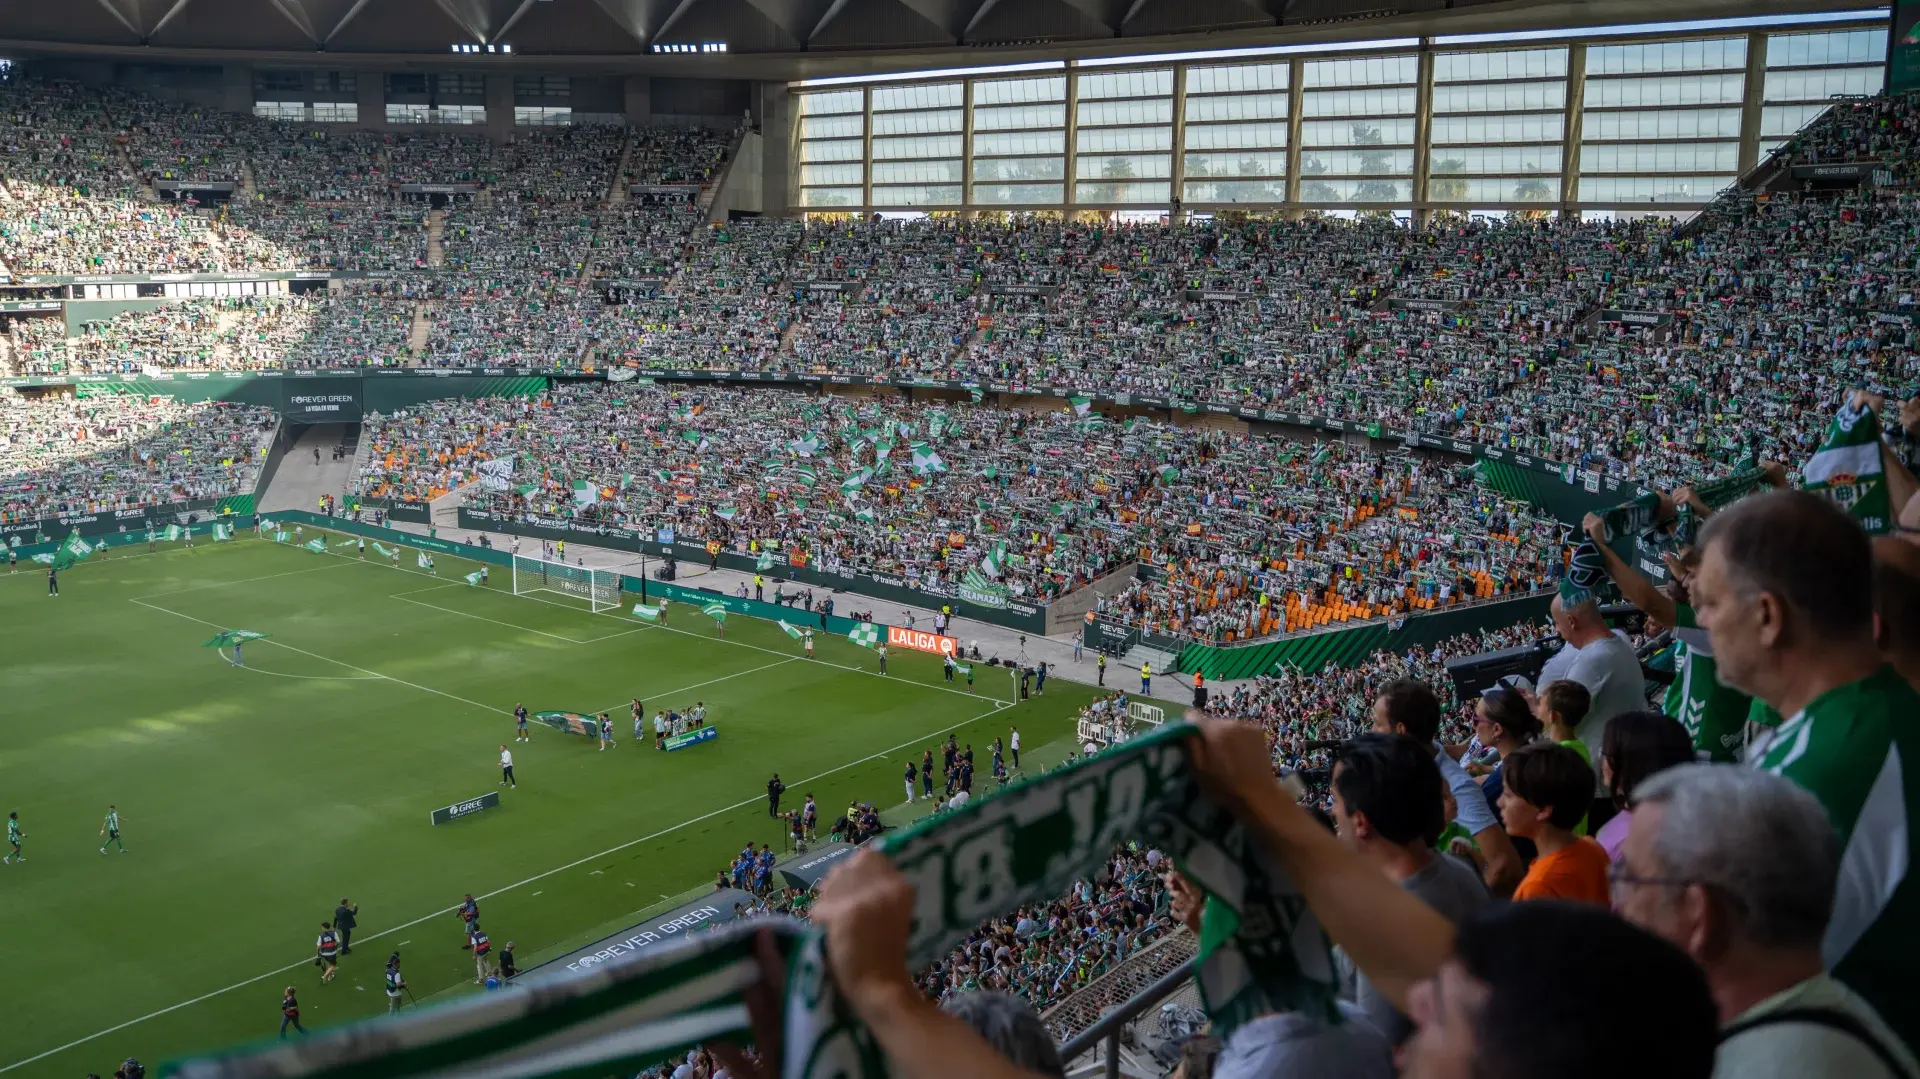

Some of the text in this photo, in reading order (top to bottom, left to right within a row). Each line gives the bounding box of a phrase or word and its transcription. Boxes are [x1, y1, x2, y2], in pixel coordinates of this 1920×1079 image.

[291, 396, 326, 404] FOREVER
[1458, 443, 1472, 451] GREE
[1515, 455, 1532, 463] REVEL
[123, 509, 144, 517] GREE
[467, 509, 489, 517] Cruzcampo
[69, 516, 97, 524] trainline
[11, 523, 38, 531] CaixaBank
[576, 524, 597, 533] trainlin
[561, 582, 589, 593] FOREVER
[1007, 601, 1036, 614] Cruzcampo
[1100, 623, 1129, 636] REVEL
[891, 628, 937, 650] LALIGA
[459, 799, 483, 812] GREE
[799, 847, 849, 870] FOREVER GREEN
[566, 905, 720, 972] FOREVER GREEN
